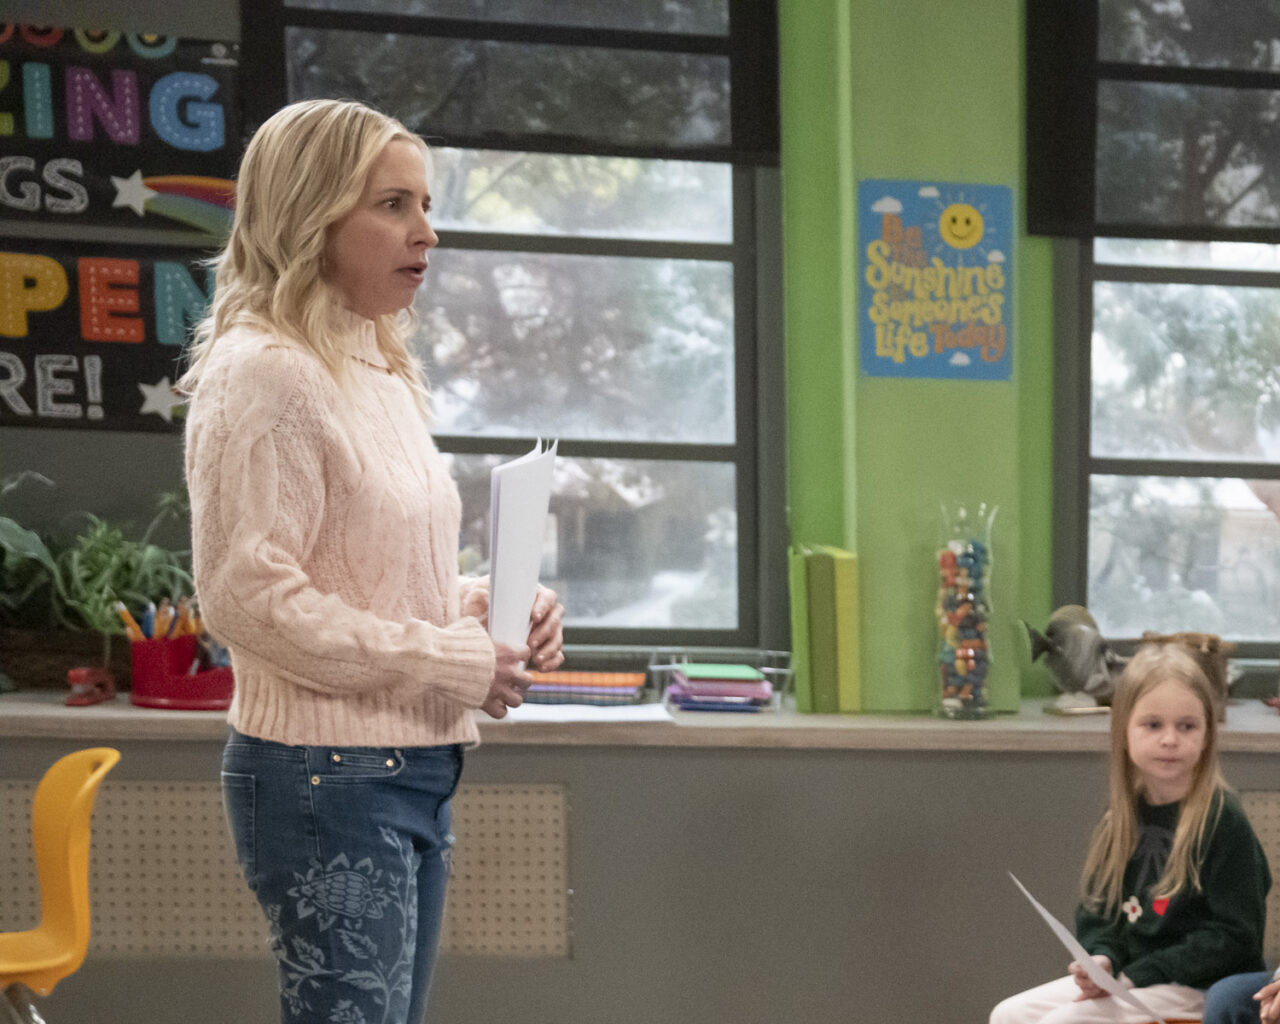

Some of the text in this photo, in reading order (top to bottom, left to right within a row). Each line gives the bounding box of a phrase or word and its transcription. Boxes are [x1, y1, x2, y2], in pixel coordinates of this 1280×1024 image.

[0, 60, 225, 152] ING
[0, 156, 90, 214] GS
[866, 240, 1004, 299] Sunshine
[875, 322, 1006, 363] Life Today
[0, 352, 104, 420] RE!
